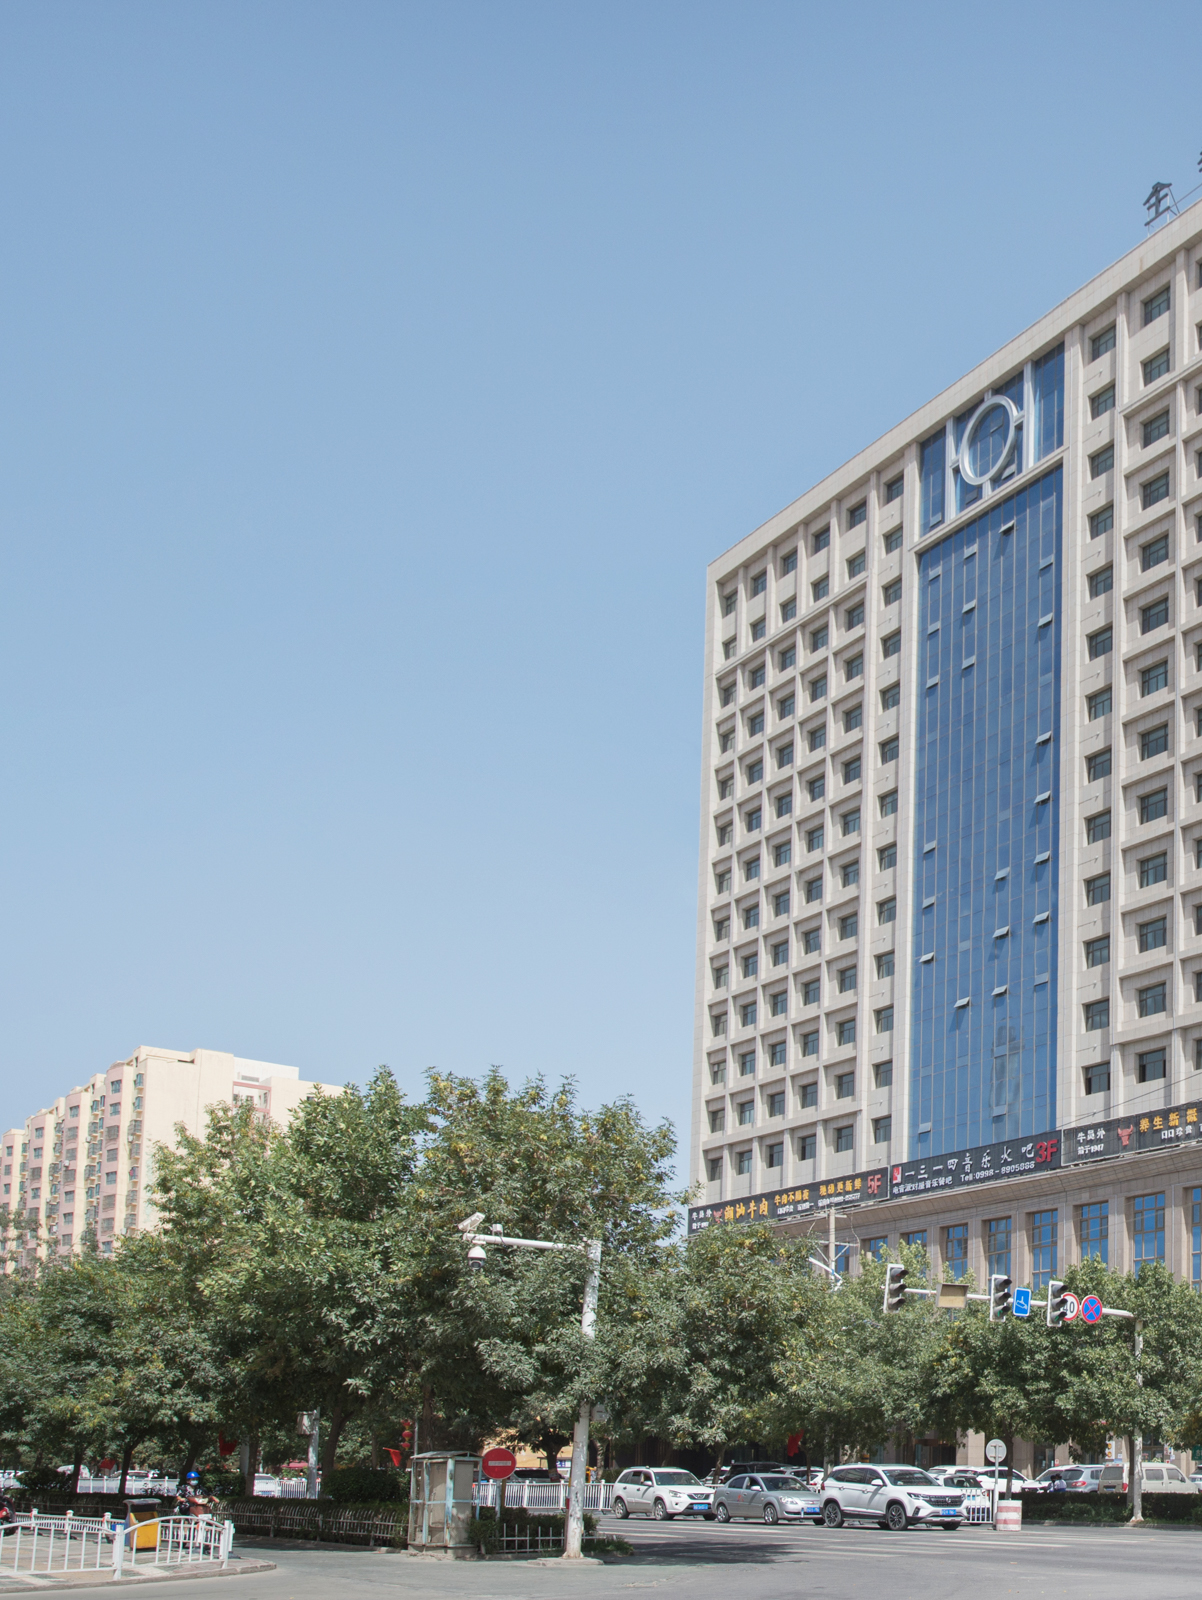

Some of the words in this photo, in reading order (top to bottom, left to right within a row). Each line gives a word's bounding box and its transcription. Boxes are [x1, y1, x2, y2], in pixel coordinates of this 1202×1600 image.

[1077, 1127, 1106, 1143] 牛员外
[1035, 1139, 1058, 1164] 3F
[867, 1174, 882, 1194] 5F
[1063, 1301, 1075, 1314] 40
